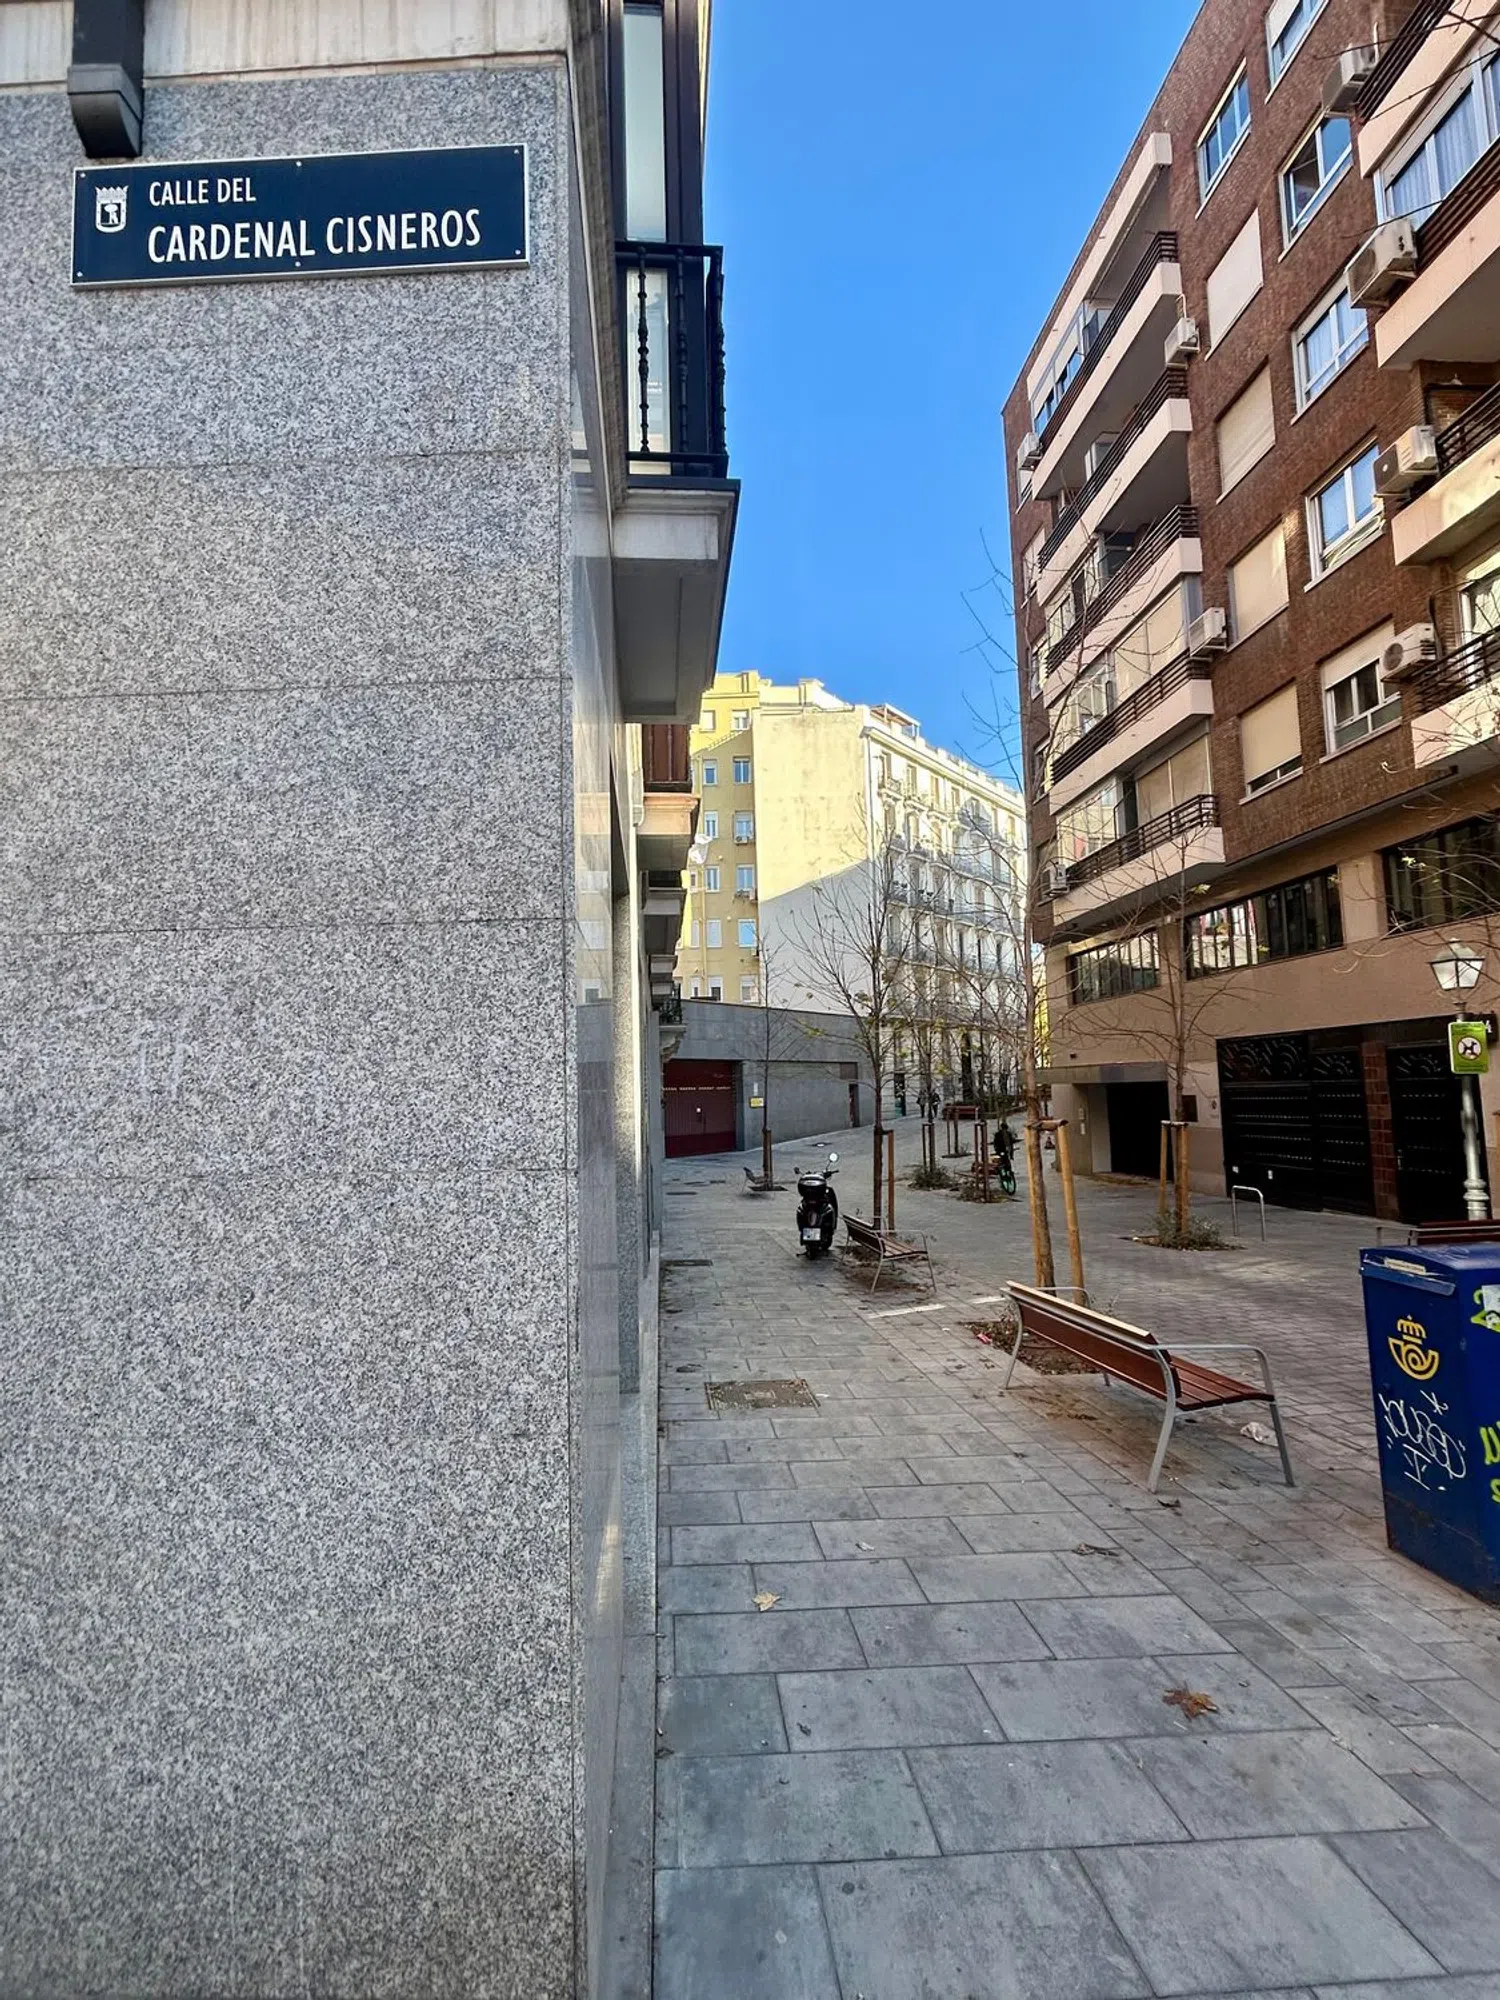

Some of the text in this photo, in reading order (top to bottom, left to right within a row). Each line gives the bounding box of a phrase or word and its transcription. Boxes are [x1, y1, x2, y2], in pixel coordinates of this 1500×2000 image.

[149, 177, 257, 207] CALLE DEL
[148, 208, 481, 263] CARDENAL CISNEROS
